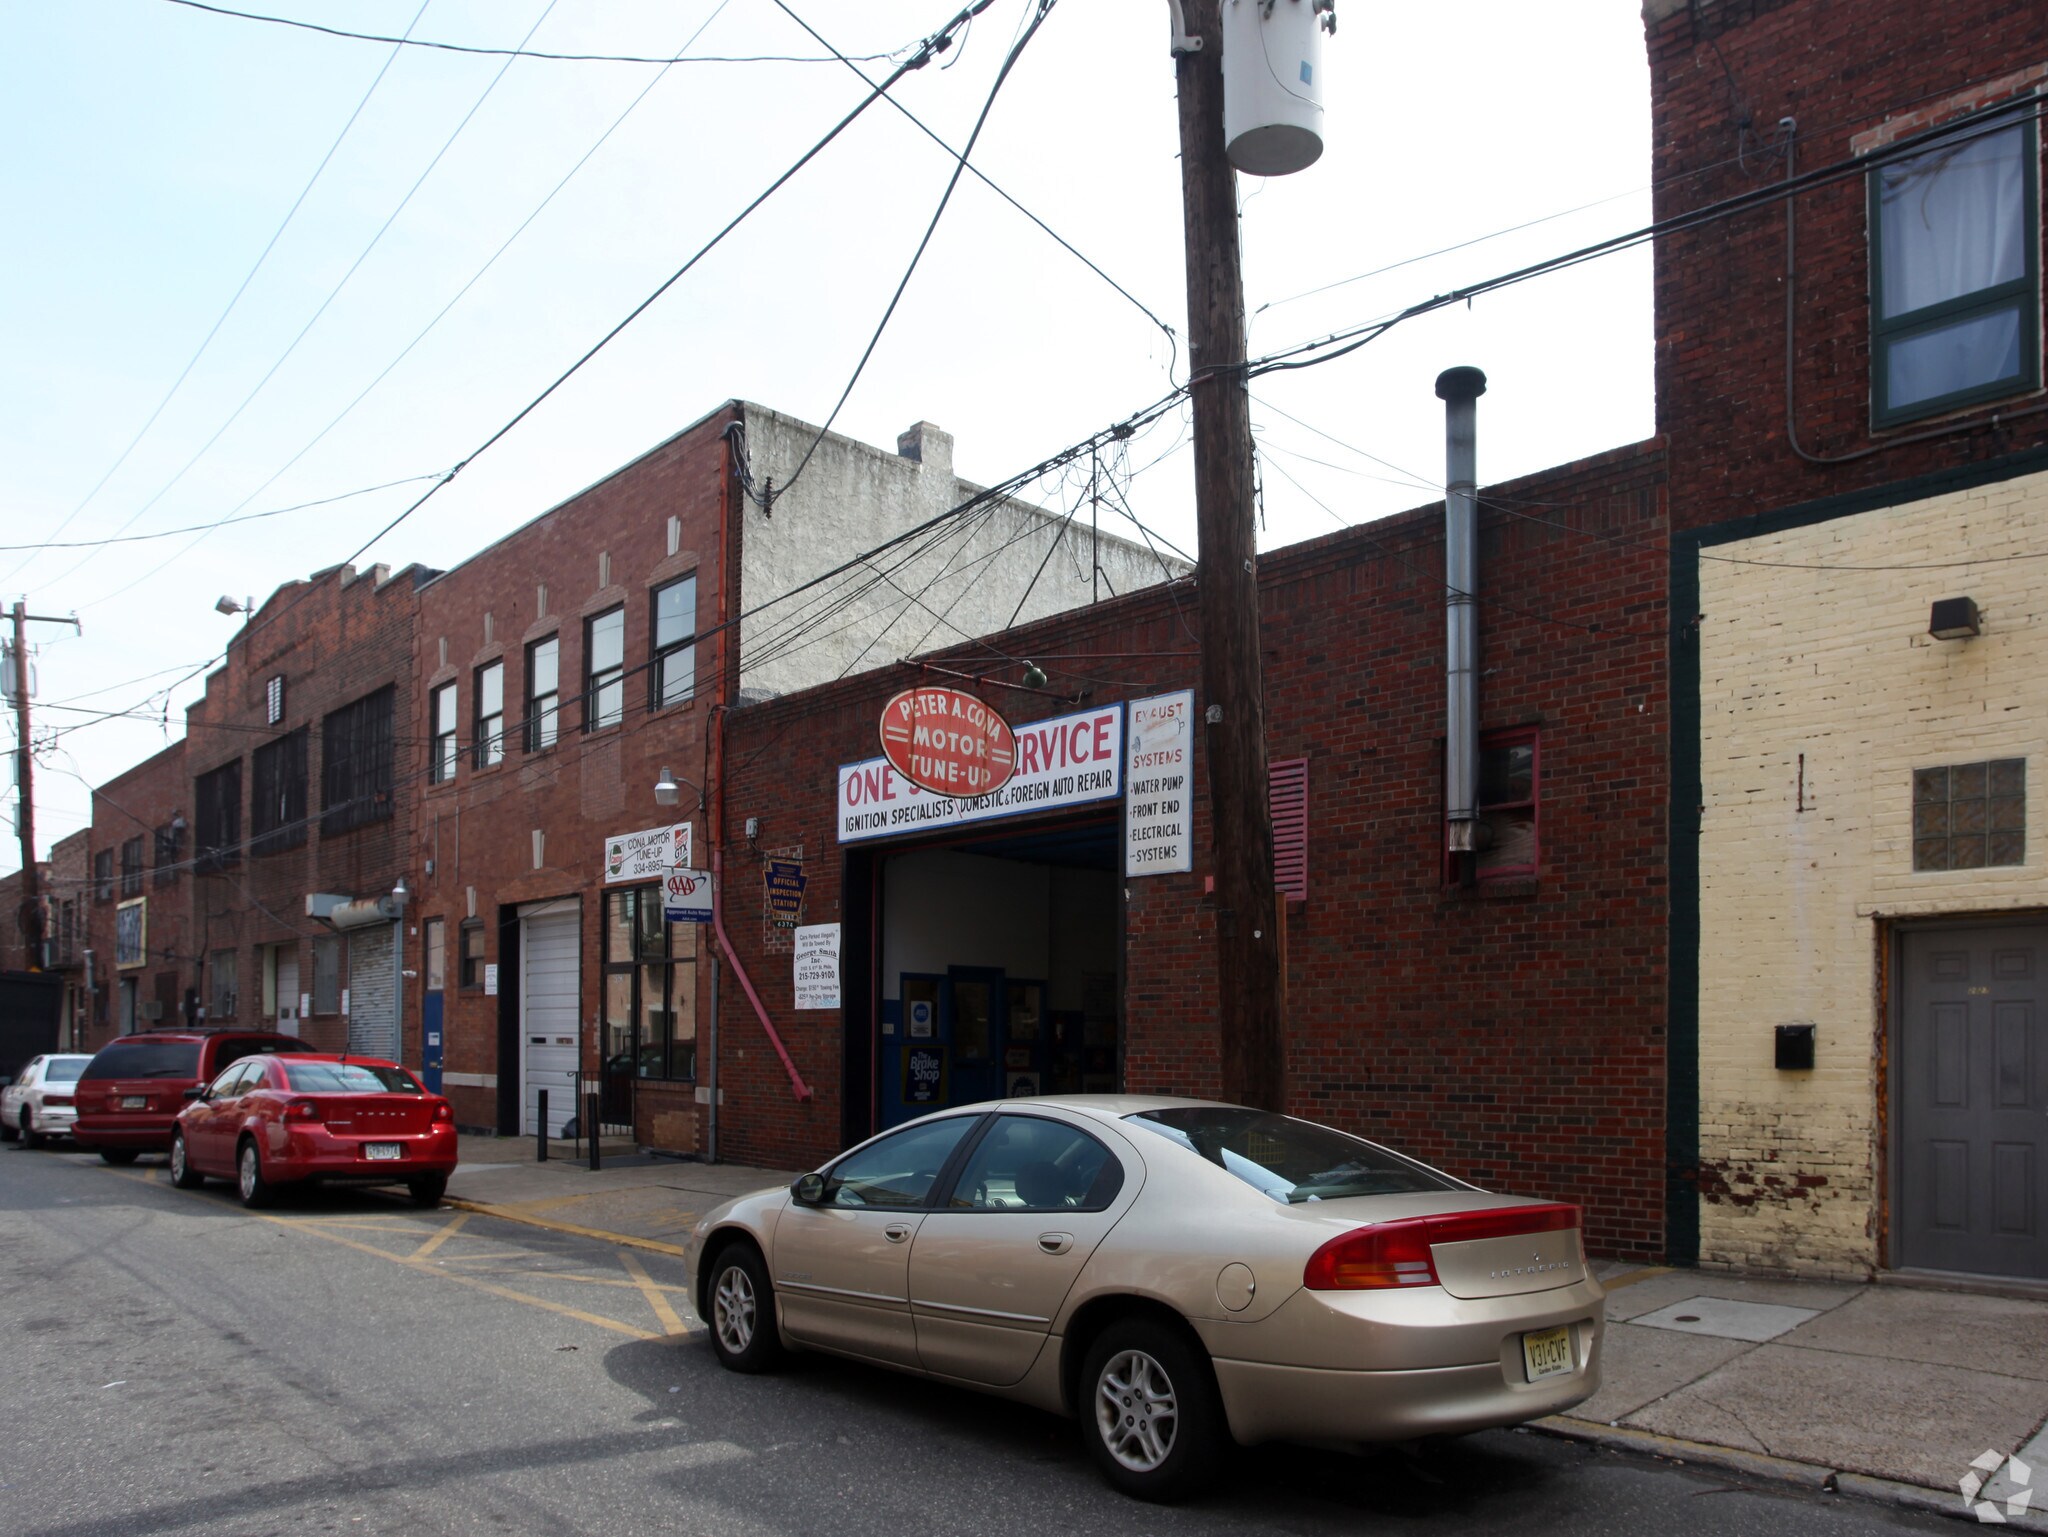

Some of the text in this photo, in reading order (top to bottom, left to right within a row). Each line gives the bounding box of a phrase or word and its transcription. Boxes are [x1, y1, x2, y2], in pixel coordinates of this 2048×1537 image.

[899, 694, 1001, 742] PETER A. CONA
[912, 725, 989, 759] MOTOR
[1133, 749, 1183, 769] SYSTEMS
[908, 753, 991, 787] TUNE-UP
[847, 765, 896, 807] ONE
[1133, 775, 1184, 796] WATER PUMP
[845, 811, 888, 832] IGNITION
[891, 797, 954, 825] SPECIALISTS
[960, 788, 1004, 813] DOMESTIC
[1011, 780, 1050, 805] FOREIGN
[1052, 775, 1074, 798] AUTO
[1078, 769, 1112, 793] REPAIR
[1132, 800, 1180, 819] FRONT END
[627, 832, 670, 850] CONA MOTOR
[1132, 823, 1182, 841] ELECTRICAL
[636, 847, 662, 861] TUNE-UP
[675, 841, 688, 859] GTX
[1136, 845, 1177, 862] SYSTEMS
[671, 876, 694, 895] AAA
[773, 877, 800, 887] OFFICIAL
[770, 888, 802, 898] INSPECTION
[773, 899, 797, 908] STATION
[796, 948, 837, 960] George Smith
[799, 970, 835, 980] 215-729-9100
[910, 1055, 939, 1070] Brake
[917, 1051, 928, 1059] The
[914, 1068, 940, 1084] Shop
